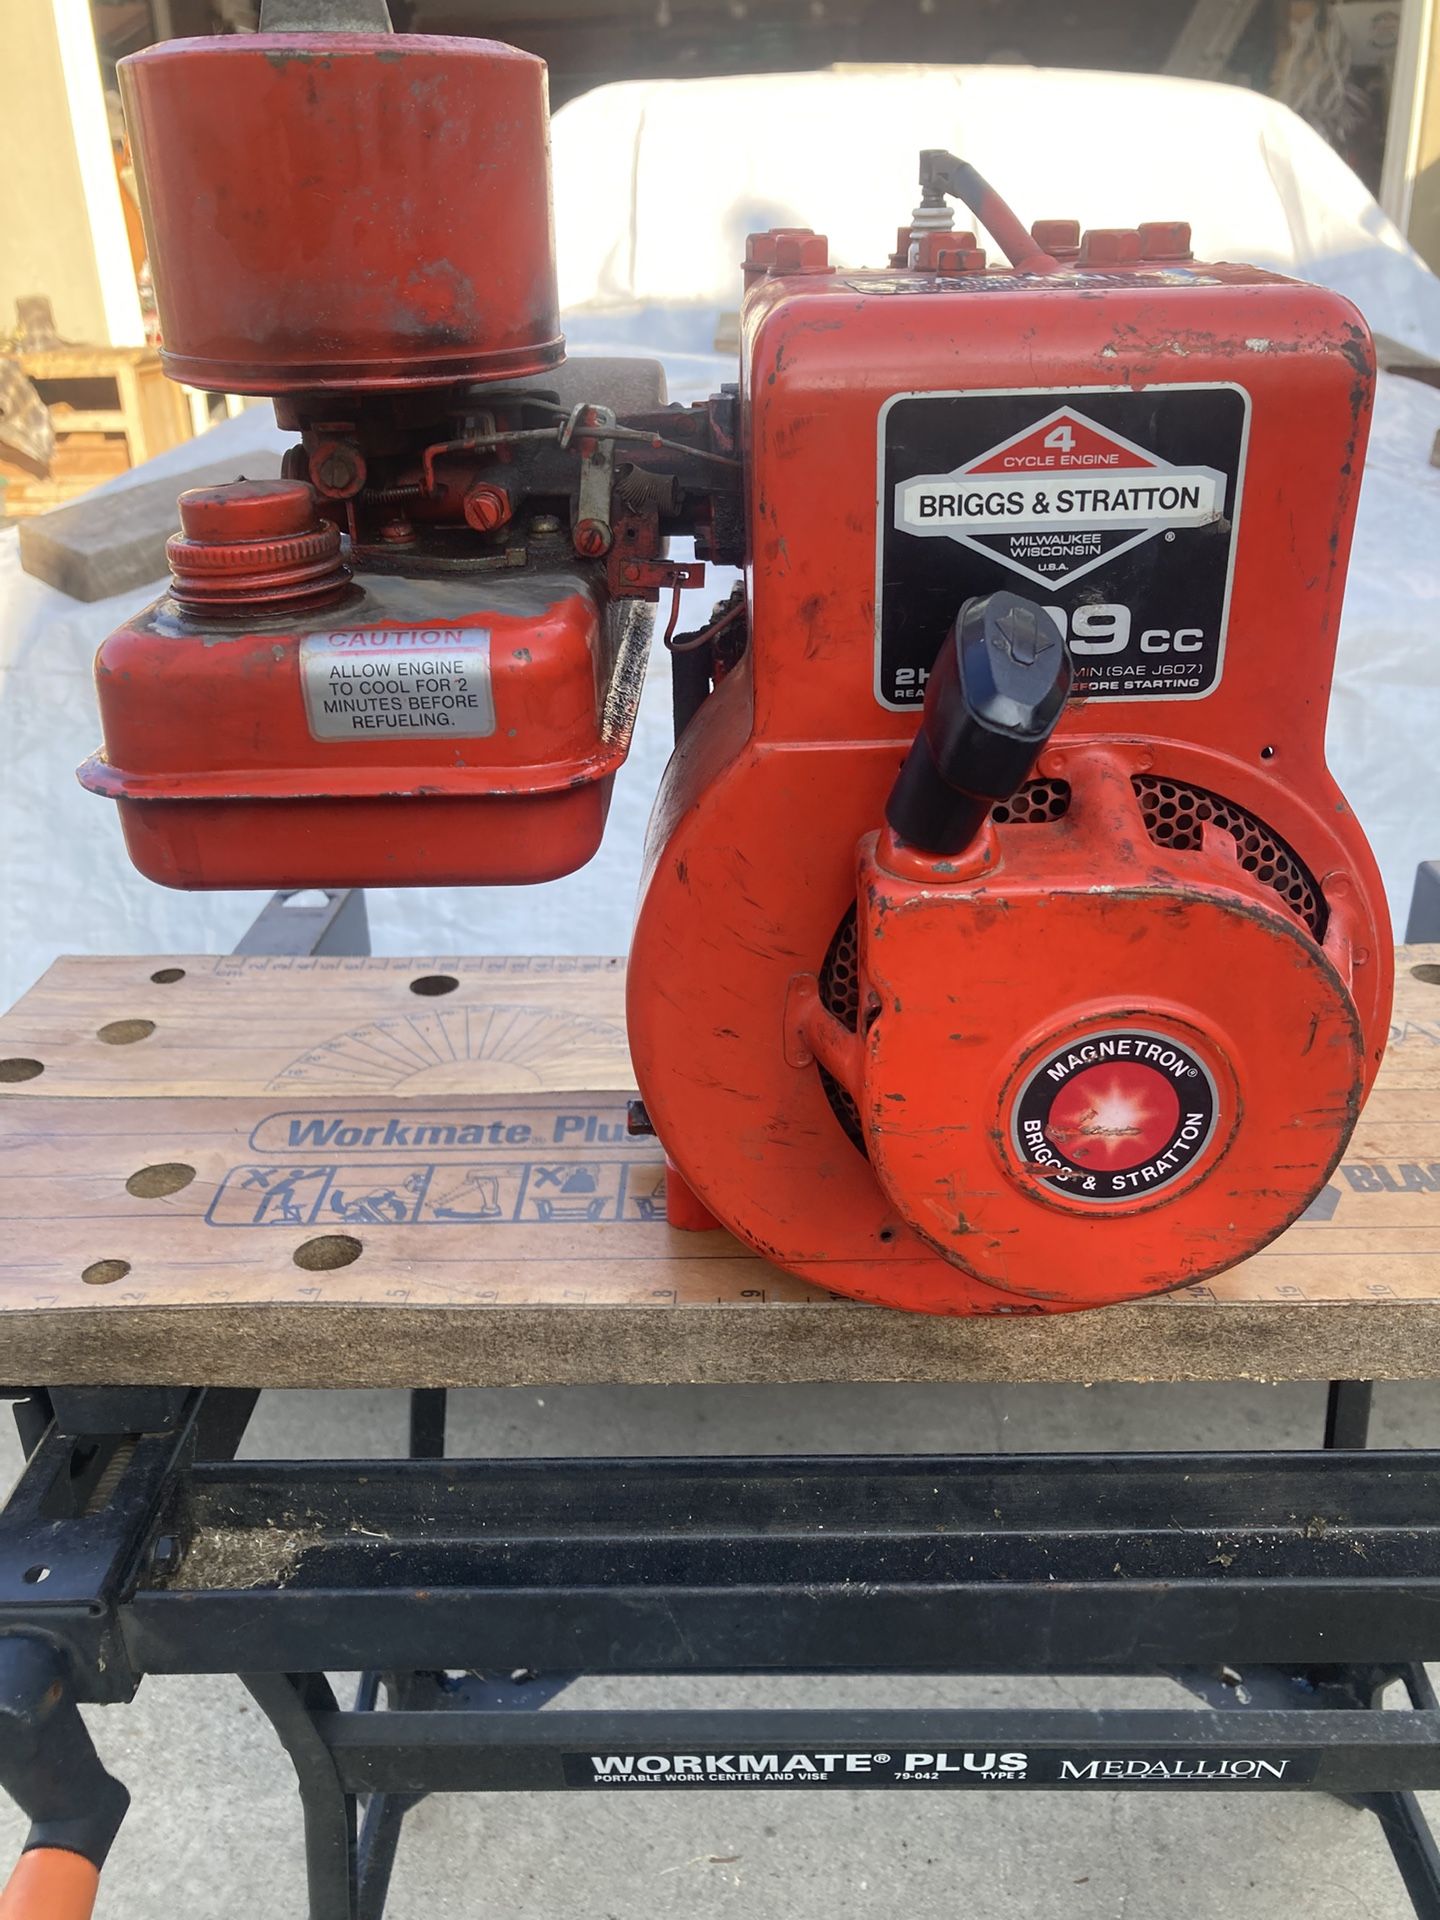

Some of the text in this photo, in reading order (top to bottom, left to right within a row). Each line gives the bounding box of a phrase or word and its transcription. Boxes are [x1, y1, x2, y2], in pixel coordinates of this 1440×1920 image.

[1043, 425, 1076, 452] 4
[1003, 453, 1120, 467] CYCLE ENGINE
[919, 486, 1200, 518] BRIGGS & STRATTON
[1010, 533, 1102, 547] MILWAUKEE
[1010, 545, 1102, 558] WISCONSIN
[1038, 562, 1069, 572] U.S.A.
[328, 630, 464, 647] CAUTION
[330, 661, 464, 679] ALLOW ENGINE
[1106, 664, 1146, 677] (SAE
[1151, 662, 1203, 676] J607)
[329, 678, 468, 696] TO COOL FOR 2
[894, 678, 1200, 698] REA EFORE STARTING
[324, 694, 479, 713] MINUTES BEFORE
[352, 712, 456, 729] REFUELING.
[552, 1114, 649, 1143] Plu
[1023, 1112, 1204, 1191] BRIGGS & STRATTON
[904, 1752, 1028, 1772] PLUS
[1057, 1759, 1293, 1779] MEDALLION
[594, 1771, 1027, 1783] PORTABLE WORK CENTER AND VISE 79-042 TYPE 2
